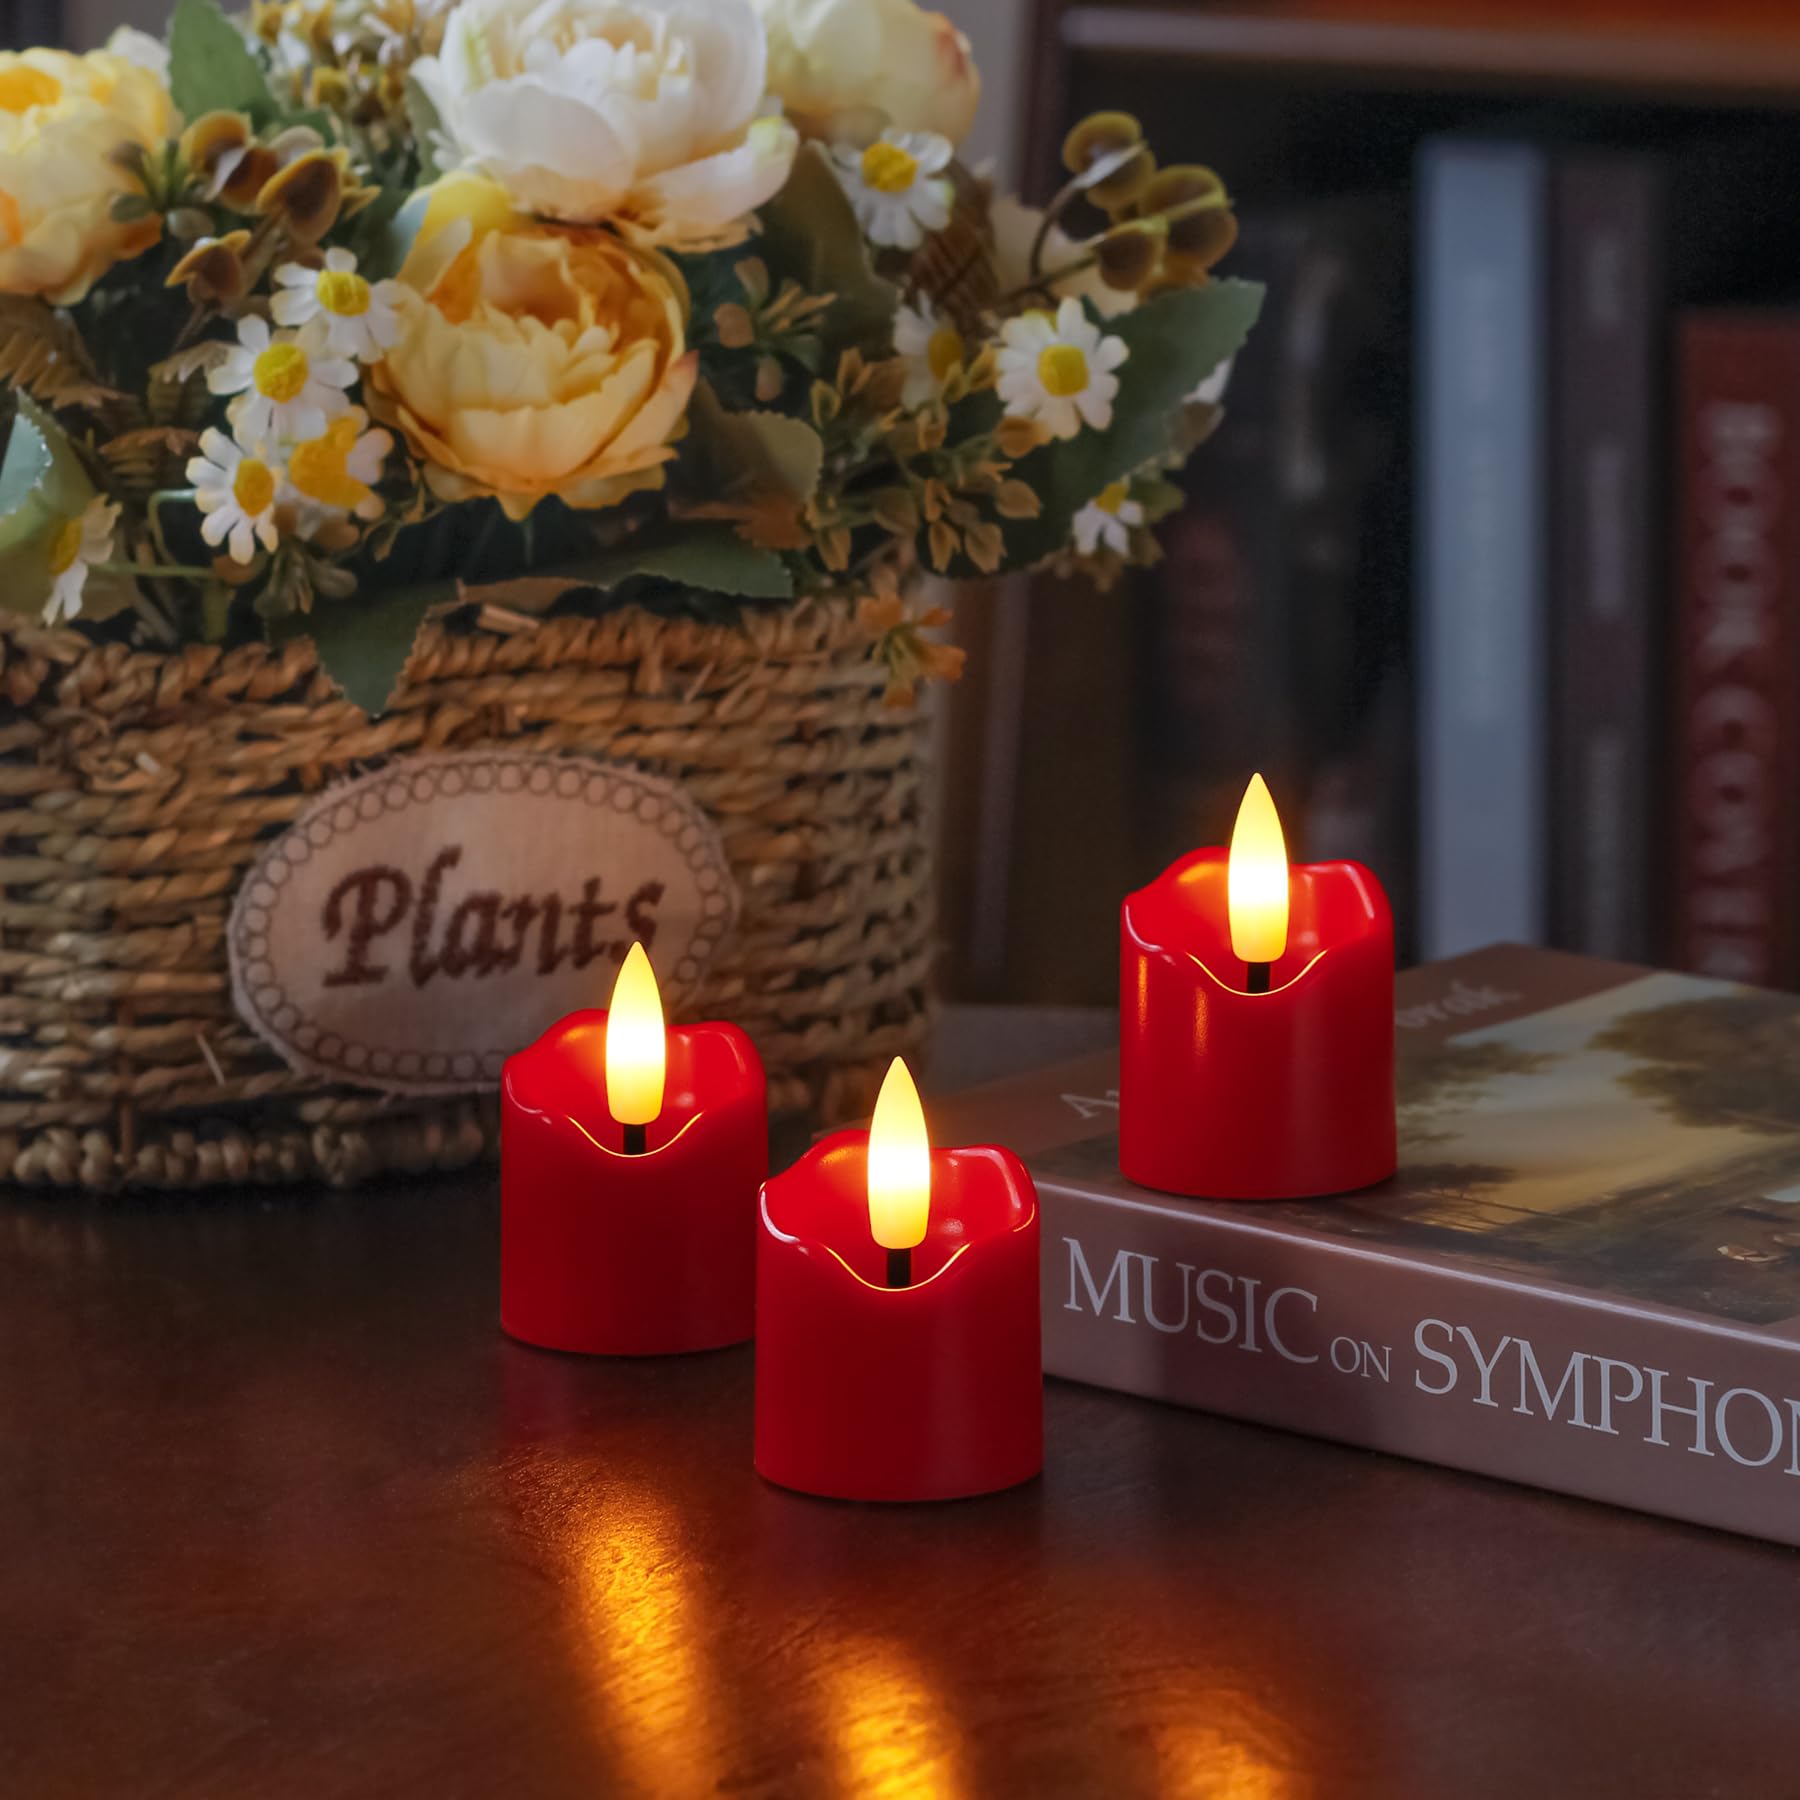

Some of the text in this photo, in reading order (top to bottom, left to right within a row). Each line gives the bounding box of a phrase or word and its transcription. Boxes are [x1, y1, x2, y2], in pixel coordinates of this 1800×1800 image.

[321, 844, 666, 989] Plants
[1061, 1237, 1319, 1364] MUSIC
[1330, 1335, 1392, 1384] ON
